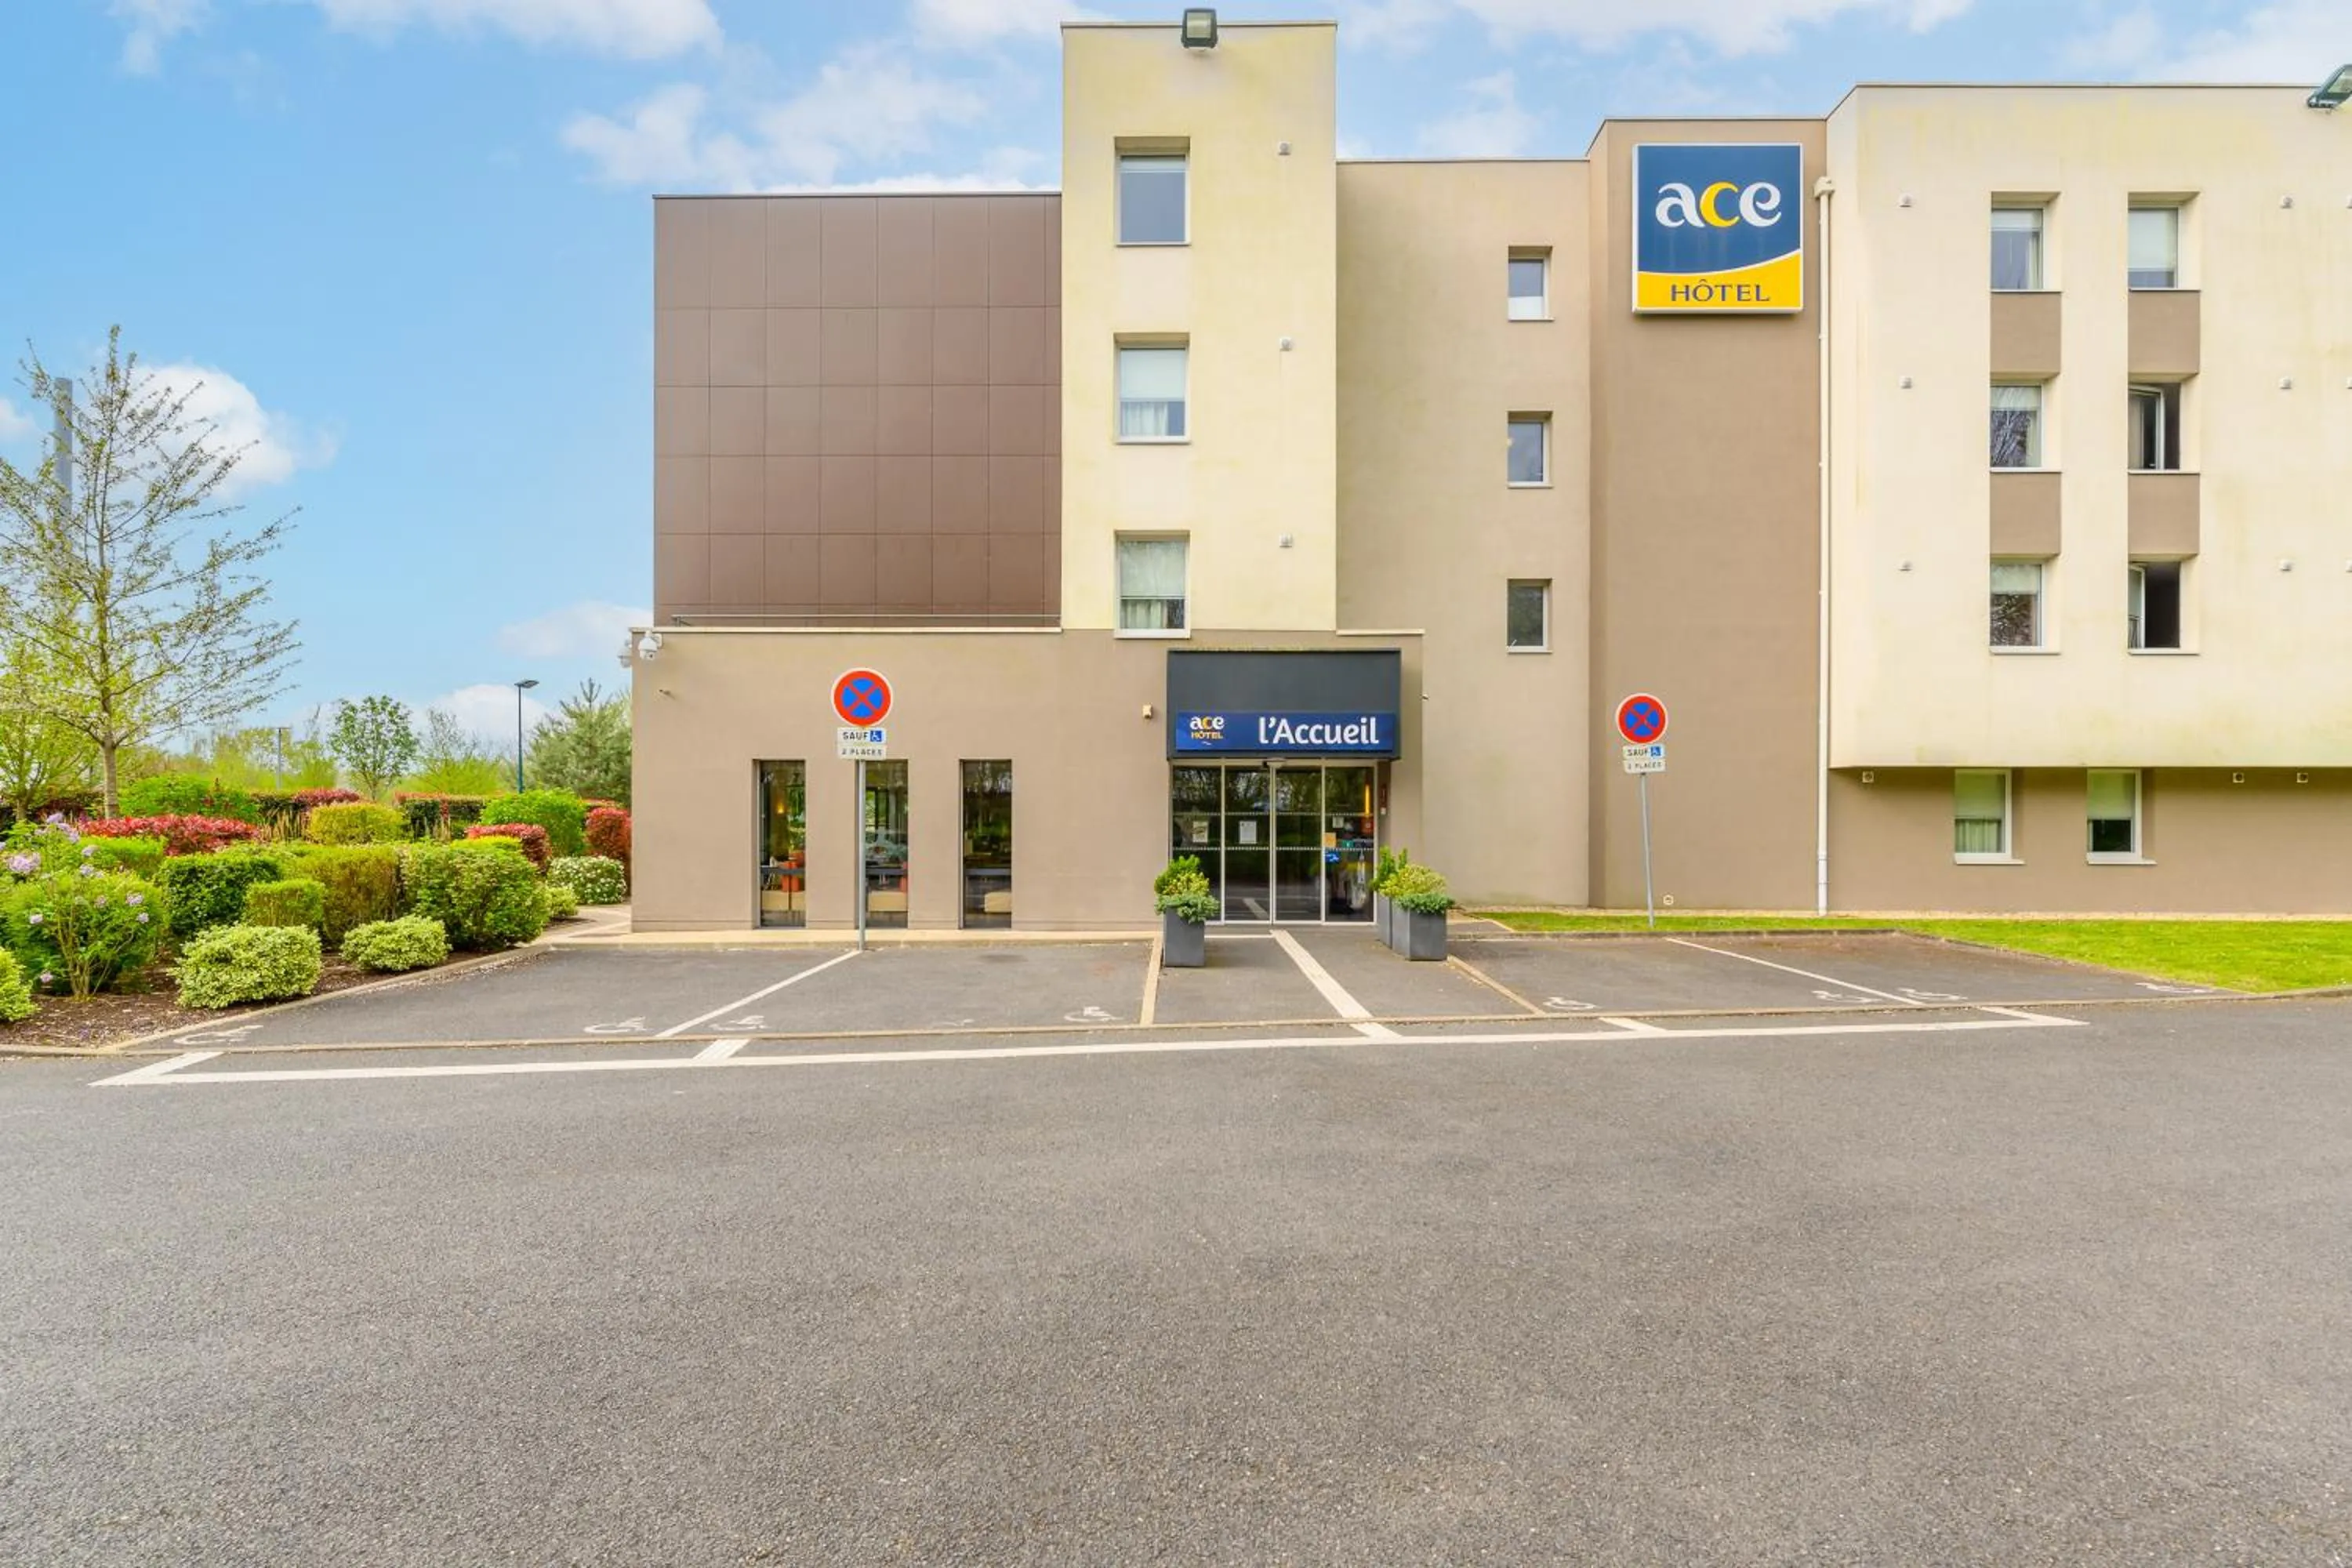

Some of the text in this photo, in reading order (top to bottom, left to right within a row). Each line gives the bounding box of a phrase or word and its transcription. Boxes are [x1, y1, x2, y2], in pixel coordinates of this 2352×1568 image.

[1655, 181, 1781, 227] ace
[1671, 279, 1770, 301] HÔTEL
[1189, 716, 1225, 730] ace
[842, 731, 869, 740] SAUF
[1191, 730, 1224, 739] HÔTEL
[1258, 717, 1379, 744] l'Accueil
[1627, 748, 1648, 757] SAUF
